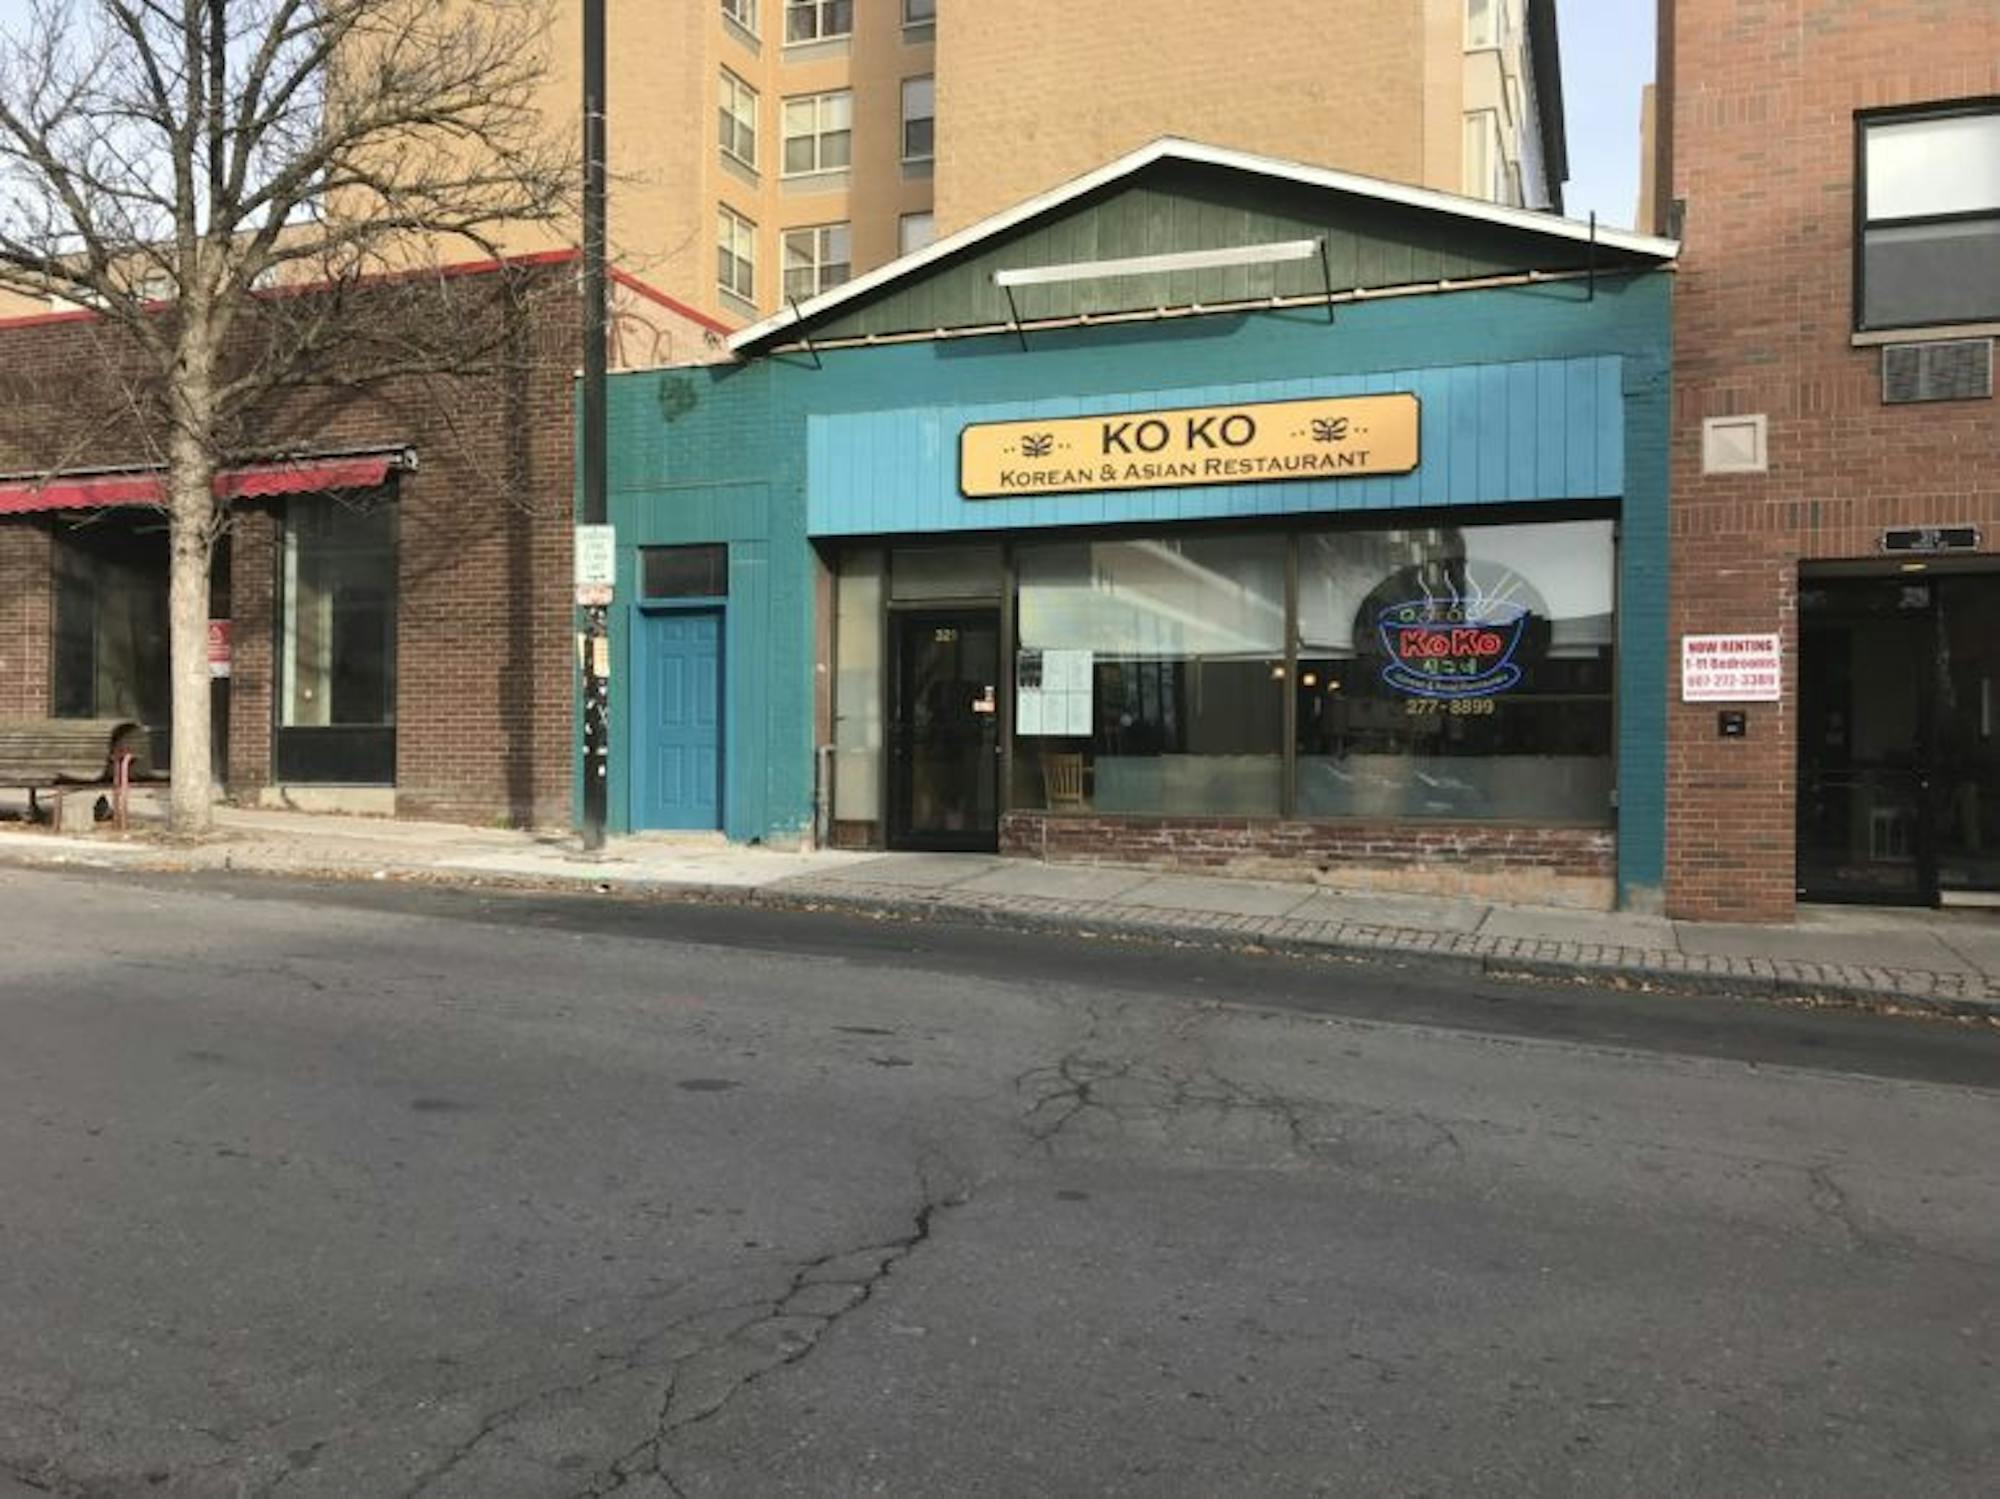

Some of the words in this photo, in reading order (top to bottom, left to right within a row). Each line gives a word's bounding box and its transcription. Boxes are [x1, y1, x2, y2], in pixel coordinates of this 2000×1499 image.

[1101, 419, 1170, 454] KO
[1187, 414, 1256, 449] KO
[1000, 467, 1093, 488] KOREAN
[1101, 464, 1117, 482] &
[1124, 460, 1197, 481] ASIAN
[1204, 450, 1371, 476] RESTAURANT
[1688, 640, 1718, 653] NOW
[1720, 640, 1773, 652] RENTING
[1406, 698, 1495, 715] 277-8899
